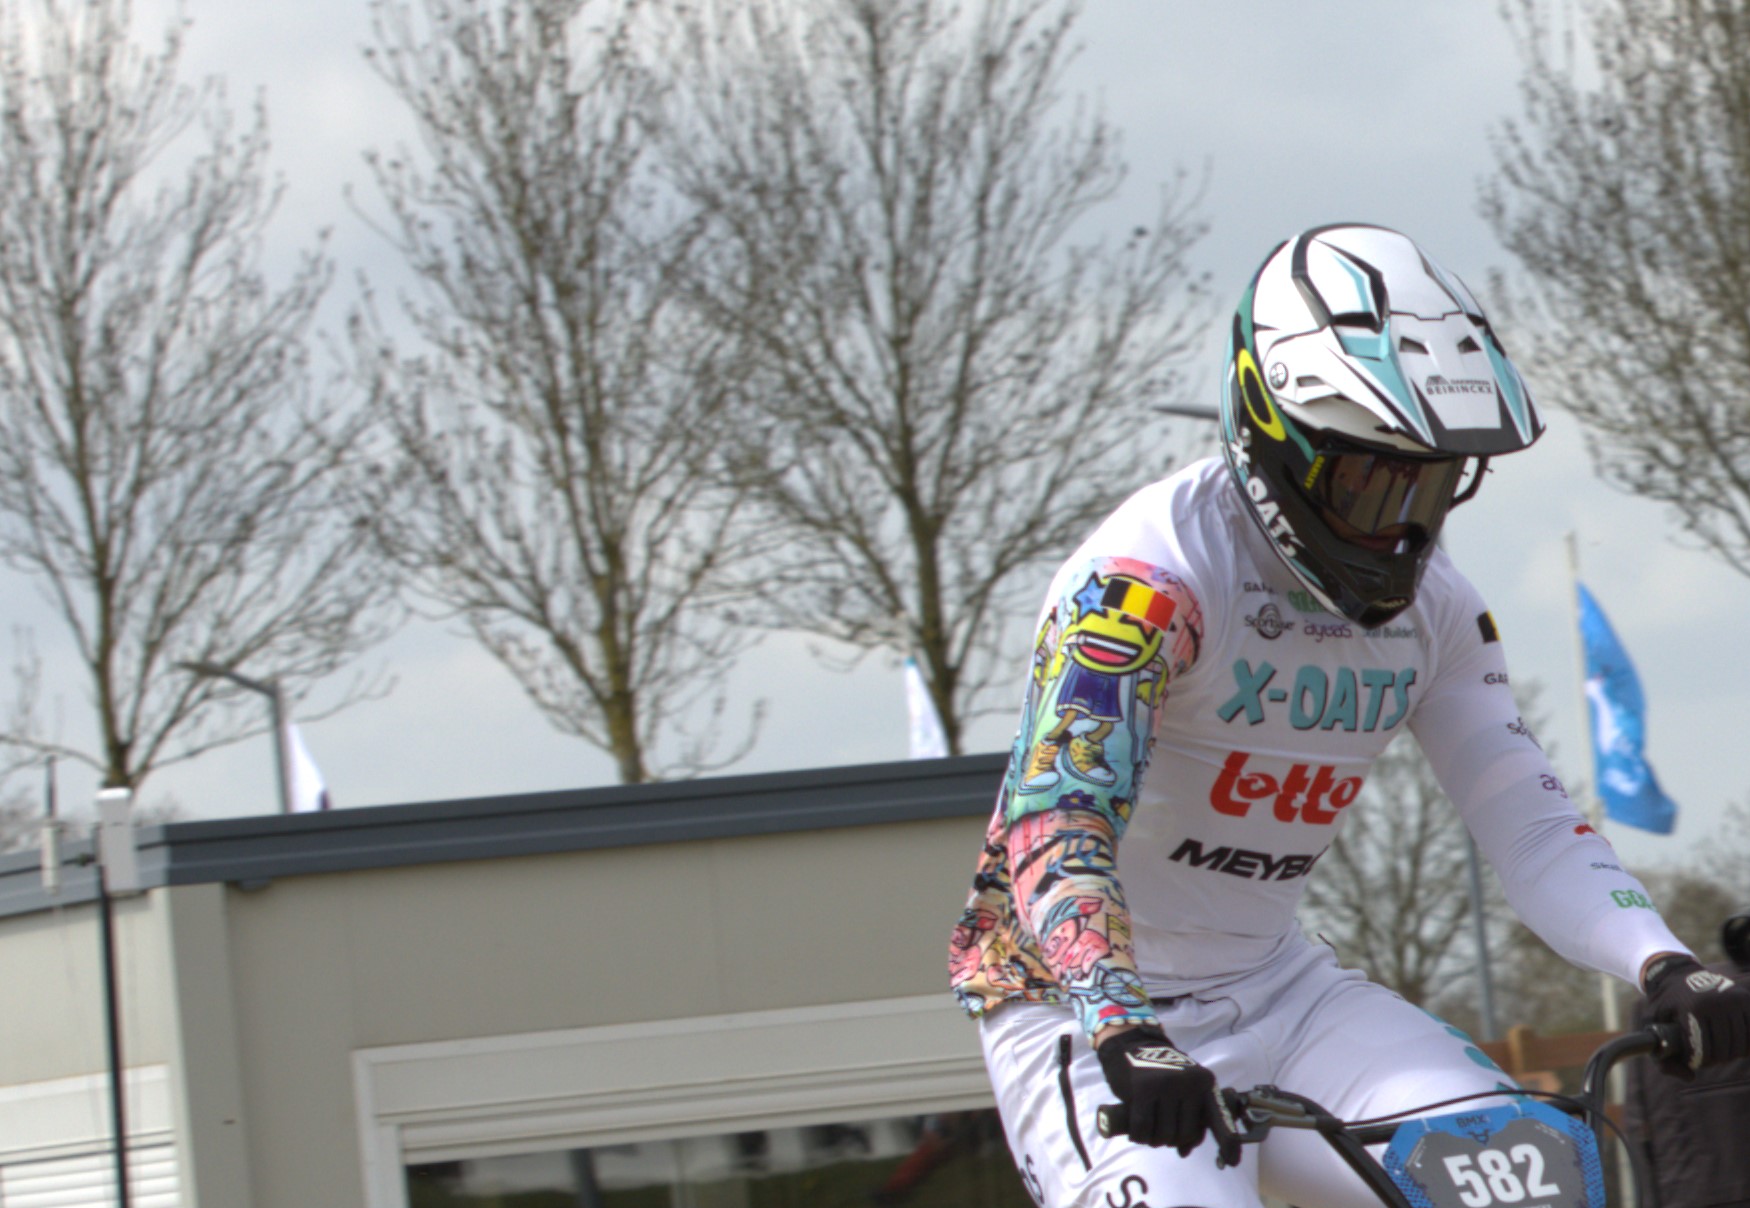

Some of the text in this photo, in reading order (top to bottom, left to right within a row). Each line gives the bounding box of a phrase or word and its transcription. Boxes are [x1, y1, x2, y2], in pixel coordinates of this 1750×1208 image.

[1215, 658, 1417, 732] X-OATS
[1168, 837, 1330, 881] MEYB
[1442, 1143, 1562, 1208] 582
